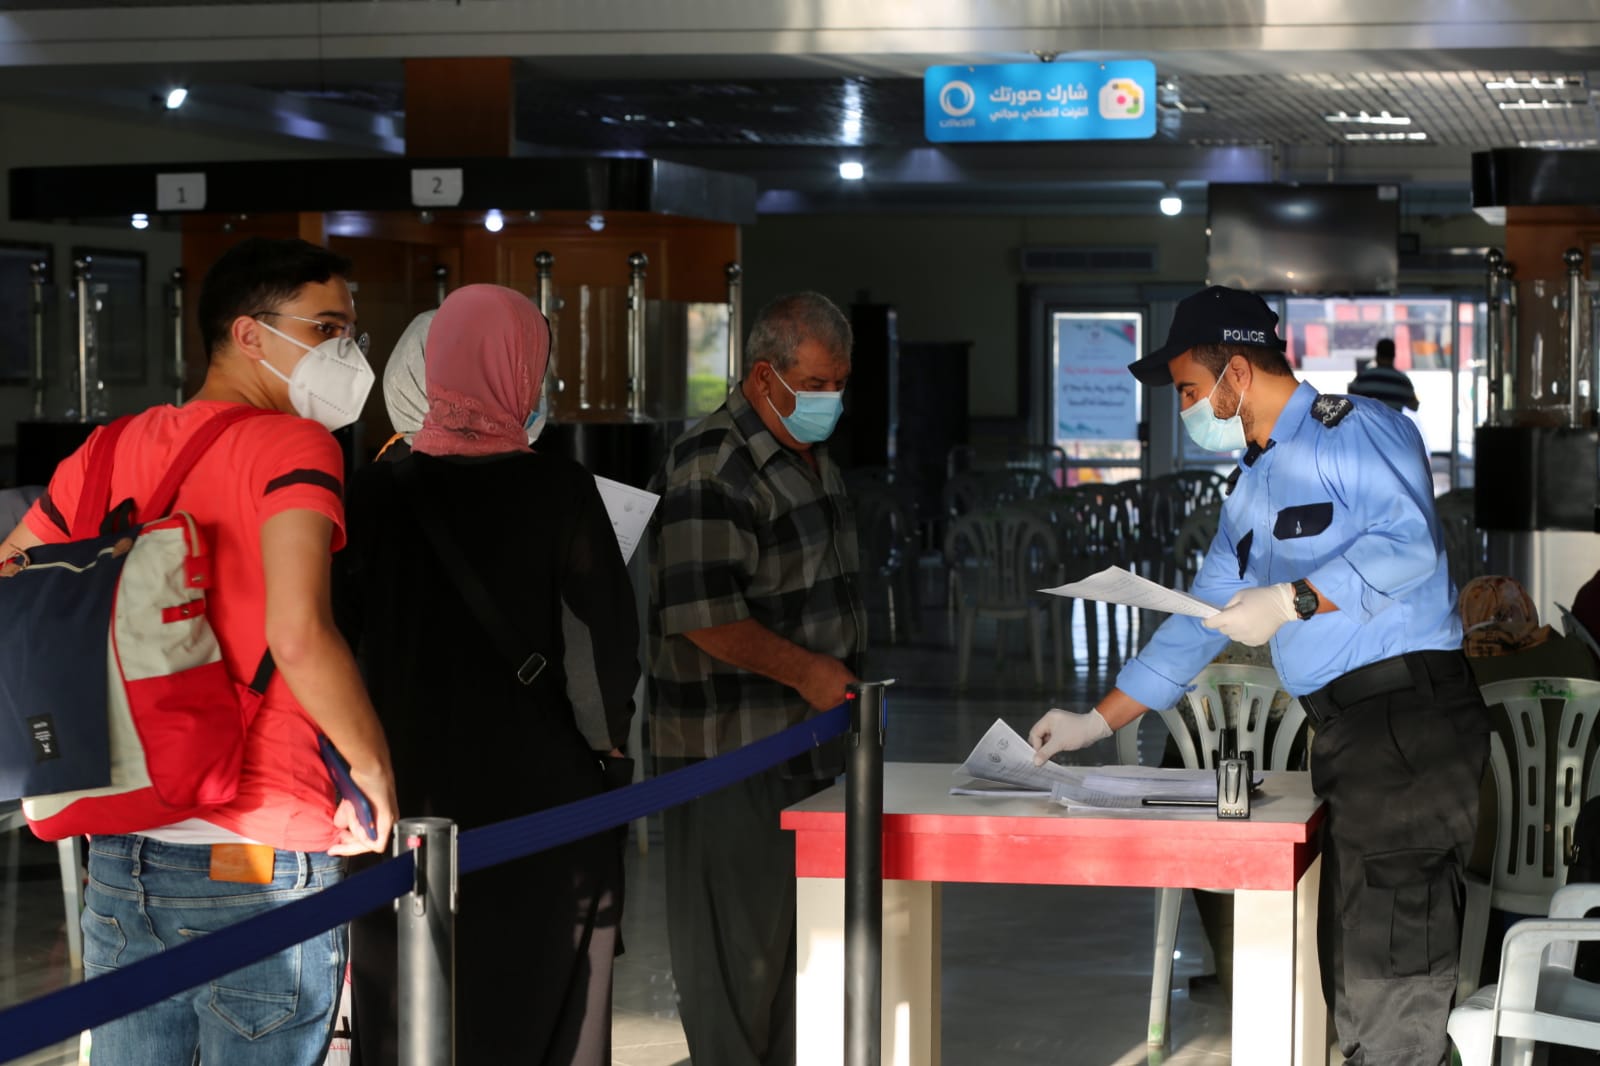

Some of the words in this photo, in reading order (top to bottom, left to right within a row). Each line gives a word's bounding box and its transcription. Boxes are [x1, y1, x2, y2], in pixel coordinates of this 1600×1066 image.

[989, 86, 1042, 106] صورتك
[1046, 83, 1088, 104] شارك
[432, 176, 444, 194] 2
[177, 187, 187, 204] 1
[1223, 328, 1266, 344] POLICE
